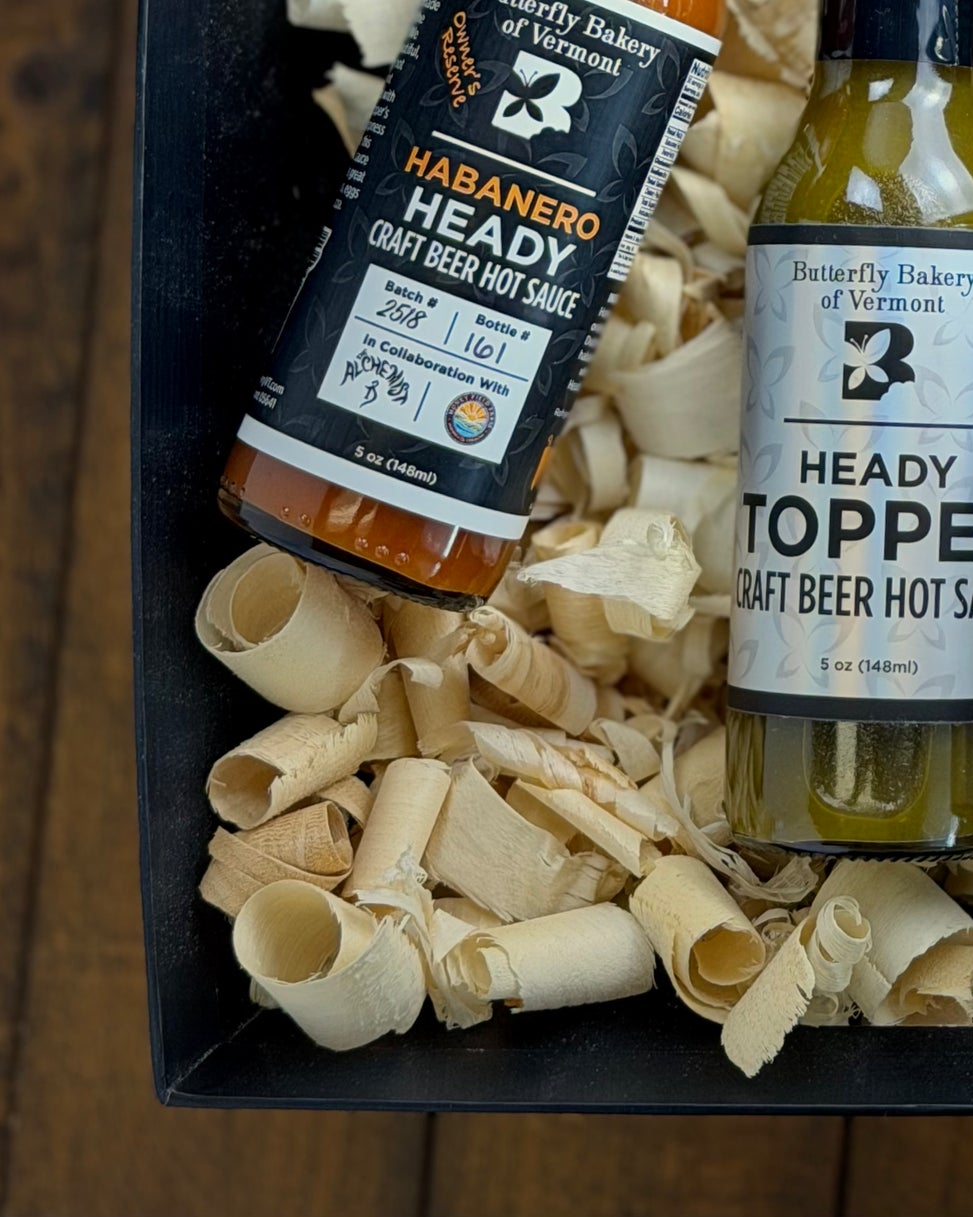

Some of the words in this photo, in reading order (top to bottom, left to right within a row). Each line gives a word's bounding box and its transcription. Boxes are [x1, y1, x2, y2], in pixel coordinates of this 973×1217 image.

[453, 11, 481, 97] Owner's
[502, 18, 529, 38] of
[532, 22, 622, 76] Vermont
[583, 14, 661, 69] Bakery
[442, 26, 467, 109] Reserve
[404, 146, 600, 241] HABANERO
[403, 186, 577, 276] HEADY
[368, 219, 427, 262] CRAFT
[424, 241, 480, 284] BEER
[478, 261, 526, 300] HOT
[522, 278, 581, 319] SAUCE
[792, 260, 890, 294] Butterfly
[376, 299, 427, 330] 2518
[385, 280, 423, 304] Batch
[427, 298, 439, 309] #
[821, 289, 844, 310] of
[848, 289, 945, 313] Vermont
[464, 333, 507, 364] 161
[475, 314, 518, 337] Bottle
[521, 330, 531, 341] #
[363, 334, 376, 347] In
[379, 340, 475, 385] Collaboration
[479, 377, 510, 397] With
[354, 445, 365, 458] 5
[366, 452, 384, 465] oz
[386, 458, 437, 485] (148ml)
[800, 450, 957, 488] HEADY
[736, 567, 790, 613] CRAFT
[798, 572, 874, 617] BEER
[884, 577, 946, 619] HOT
[820, 658, 829, 671] 5
[834, 661, 853, 671] oz
[858, 659, 918, 676] (148ml)
